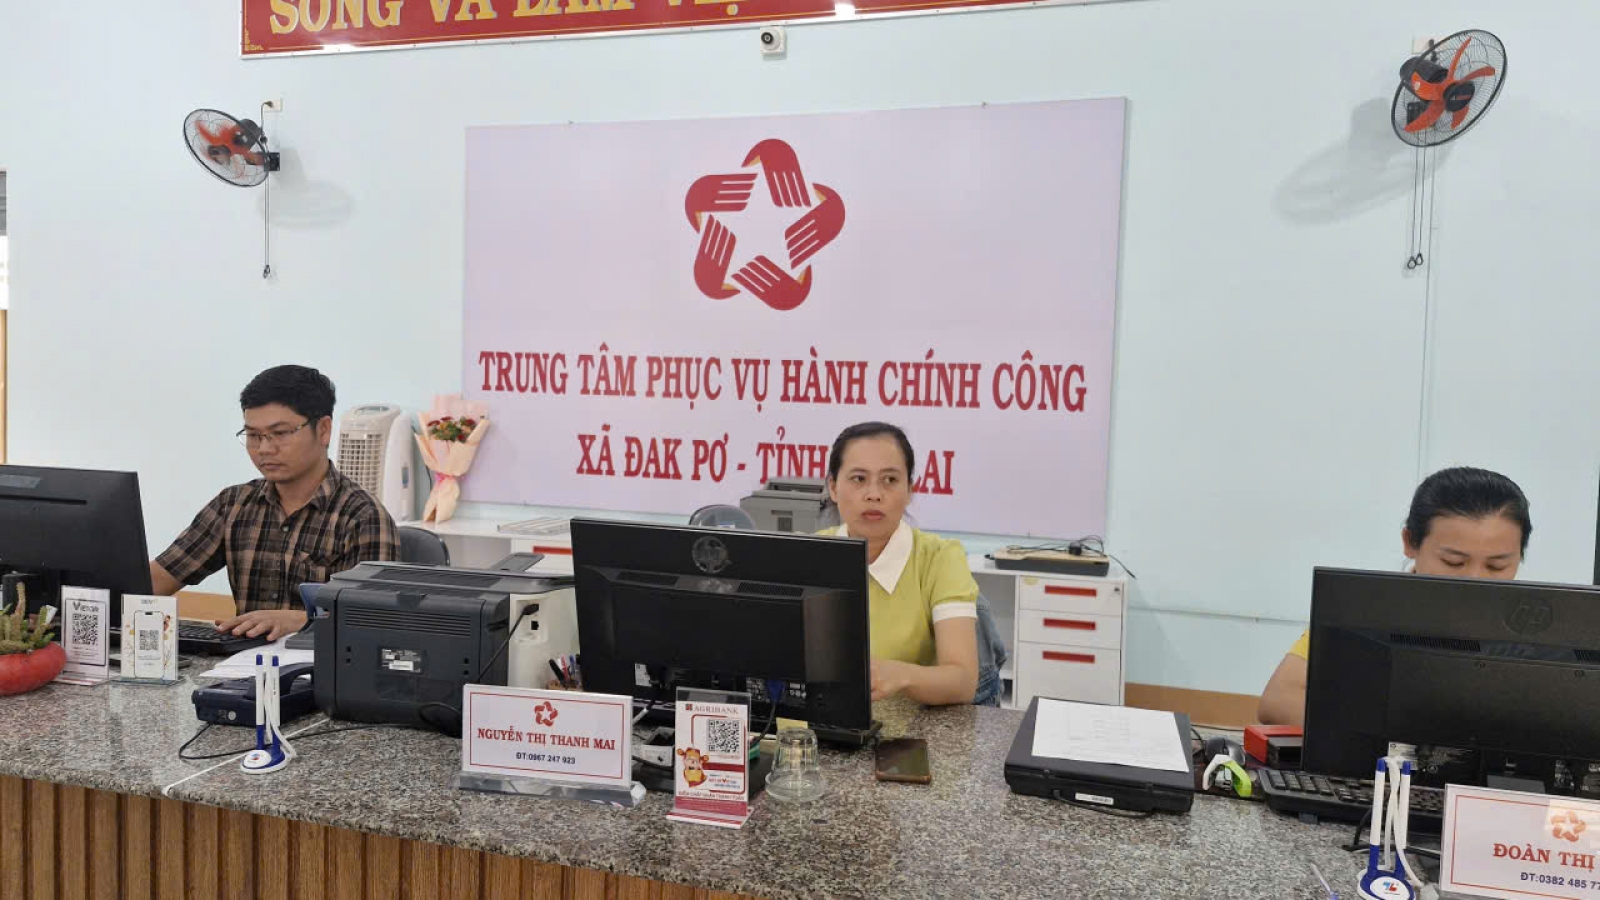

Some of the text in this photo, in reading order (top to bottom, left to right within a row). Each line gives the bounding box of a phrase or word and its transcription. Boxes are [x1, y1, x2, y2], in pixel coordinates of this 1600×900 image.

[479, 342, 1087, 412] TRUNG TÂM PHỤC VỤ HÀNH CHÍNH CÔNG
[576, 423, 616, 476] XÃ
[624, 436, 682, 480] ĐAK
[691, 432, 729, 483] PƠ
[756, 426, 829, 484] TỈNH
[912, 450, 955, 495] AI
[477, 725, 616, 750] NGUYỄN THỊ THANH MAI
[547, 755, 561, 763] 247
[562, 756, 576, 764] 923
[1493, 843, 1596, 873] ĐOÀN THỊ
[1520, 872, 1564, 886] ĐT:0382
[1568, 878, 1587, 889] 485
